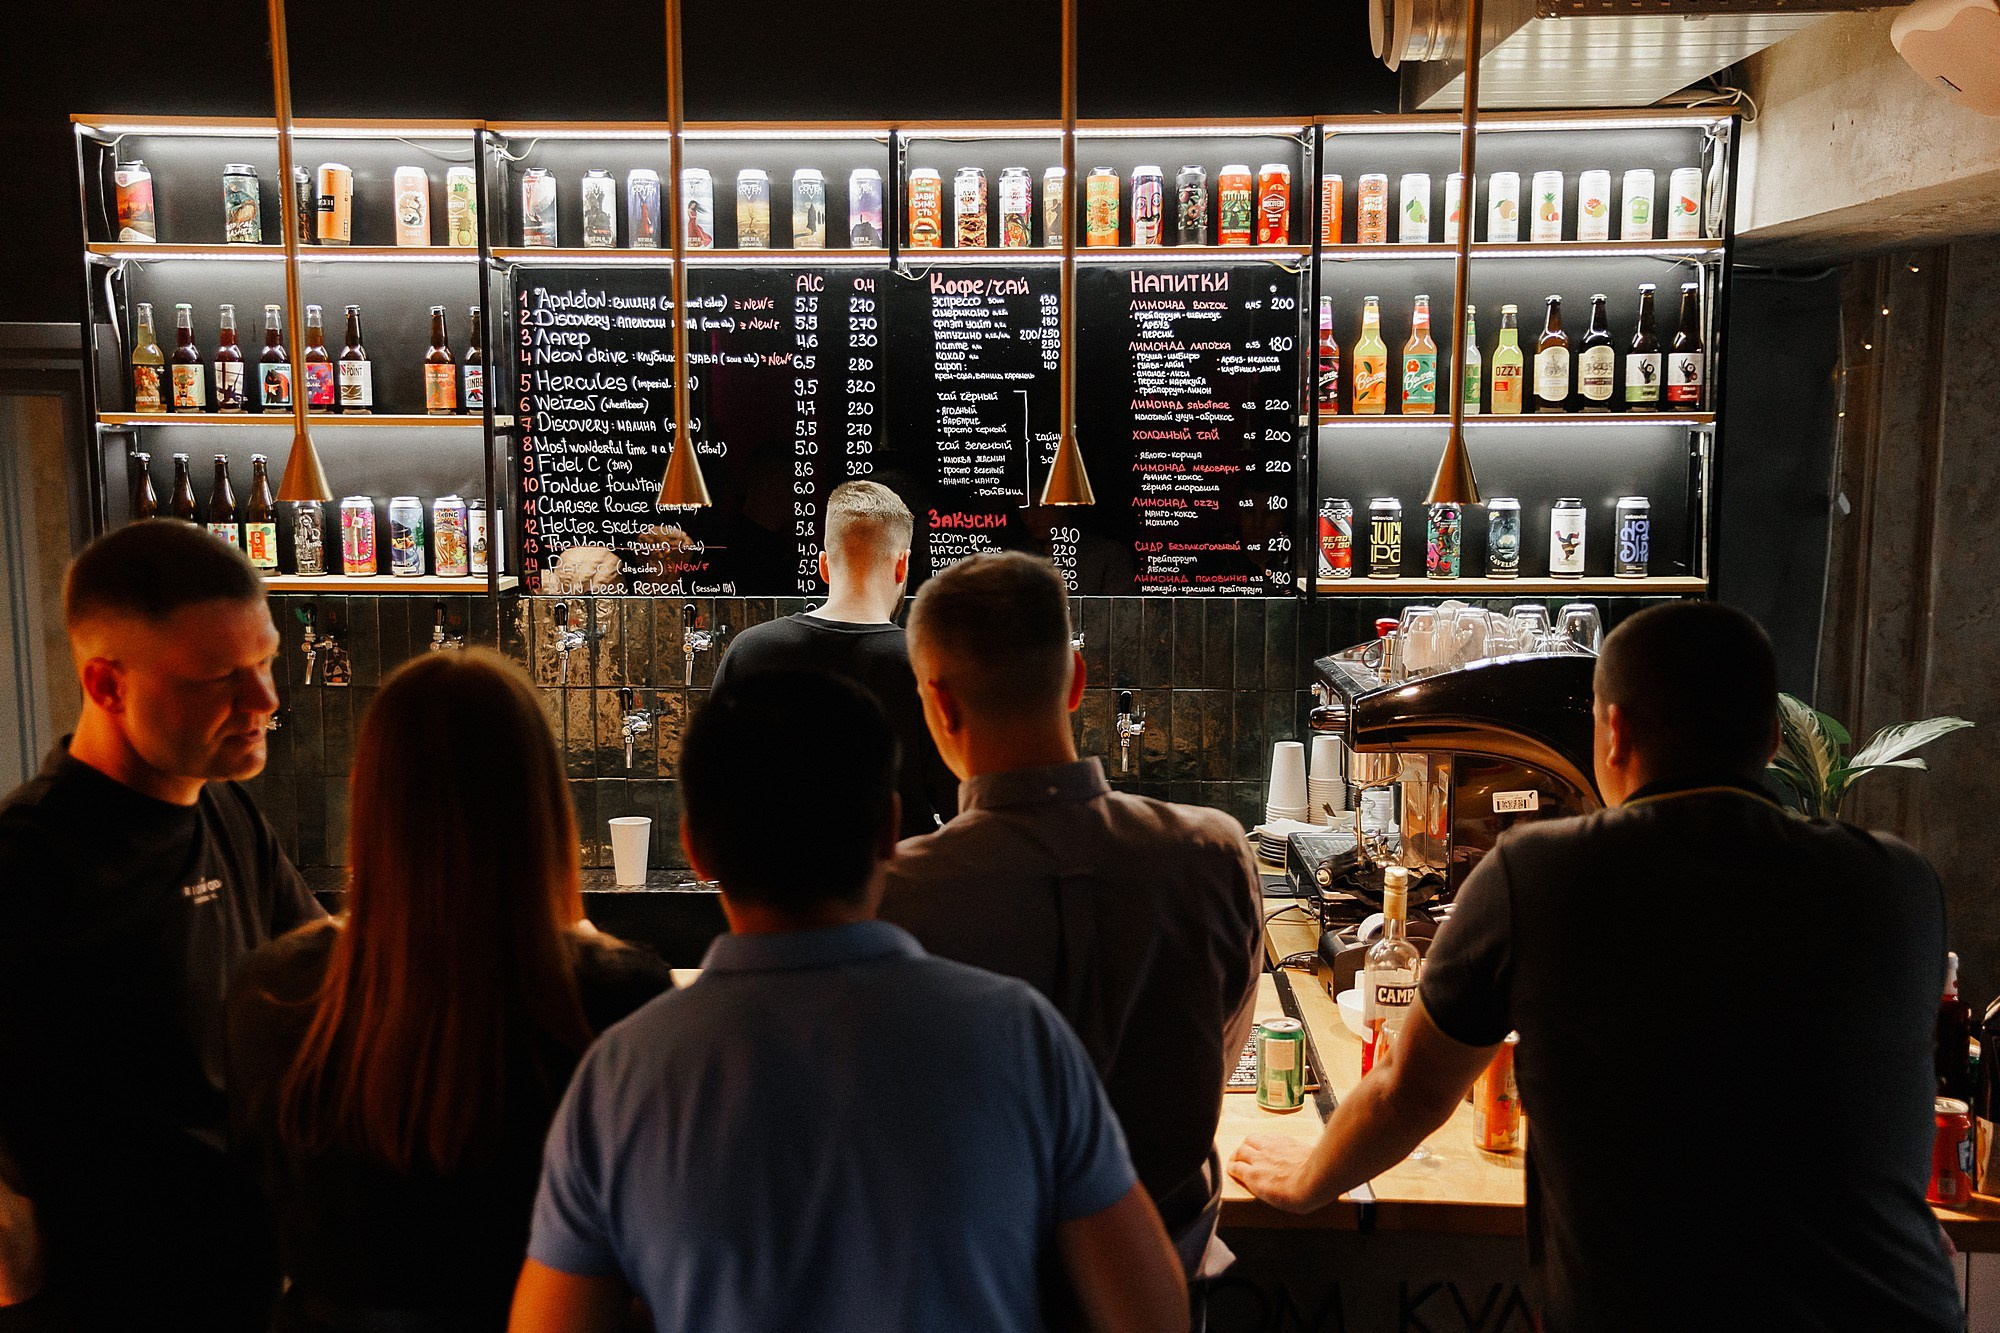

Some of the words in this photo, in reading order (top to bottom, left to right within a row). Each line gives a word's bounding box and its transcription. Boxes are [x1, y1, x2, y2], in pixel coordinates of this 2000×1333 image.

[849, 297, 876, 313] 270
[1040, 306, 1059, 316] 150
[1270, 297, 1295, 311] 200
[849, 316, 878, 331] 270
[1041, 317, 1059, 327] 180
[536, 327, 591, 350] Лагер
[849, 334, 878, 348] 230
[1041, 340, 1061, 350] 250
[1268, 336, 1293, 352] 180
[535, 345, 583, 365] Neon
[848, 357, 874, 371] 280
[1041, 350, 1060, 360] 180
[346, 366, 363, 377] POINT
[1043, 361, 1057, 371] 40
[536, 369, 628, 392] Hercules
[846, 379, 876, 394] 320
[533, 394, 599, 412] Weizen
[847, 401, 874, 416] 230
[1264, 399, 1290, 411] 220
[846, 422, 873, 436] 270
[1264, 428, 1292, 442] 200
[625, 441, 648, 456] time
[846, 441, 873, 455] 250
[537, 452, 584, 473] Fidel
[846, 461, 874, 476] 320
[1265, 460, 1292, 473] 220
[523, 477, 539, 494] 10
[540, 473, 601, 494] Fondue
[1266, 495, 1289, 511] 180
[524, 519, 540, 536] 12
[539, 515, 599, 535] Helter
[1050, 526, 1080, 544] 280
[1052, 544, 1077, 556] 220
[1267, 538, 1292, 552] 270
[1053, 556, 1077, 568] 240
[1270, 571, 1291, 585] 180
[633, 577, 688, 595] Repeat
